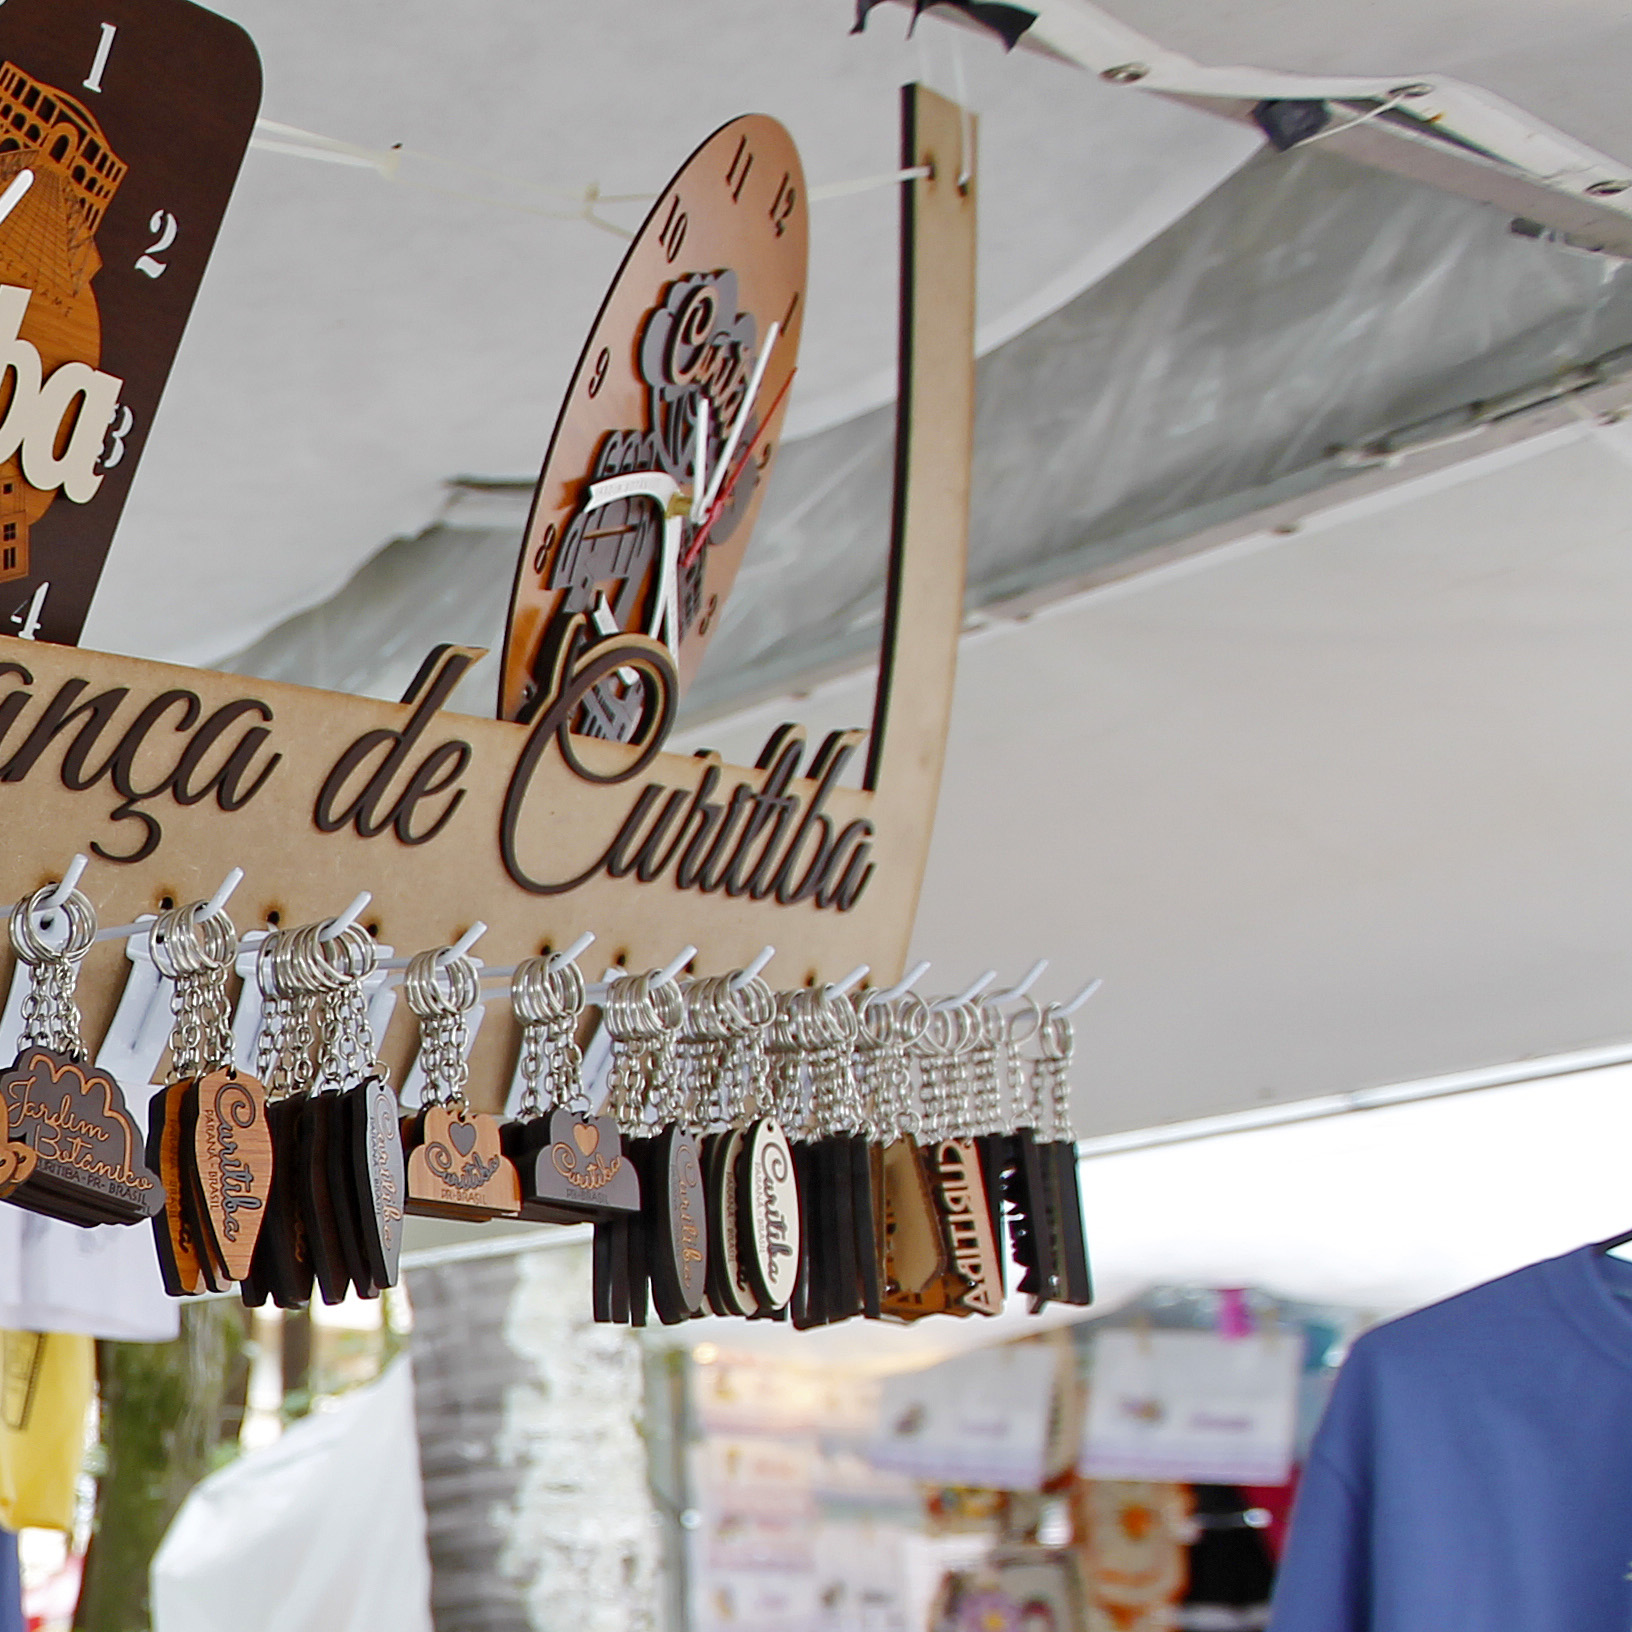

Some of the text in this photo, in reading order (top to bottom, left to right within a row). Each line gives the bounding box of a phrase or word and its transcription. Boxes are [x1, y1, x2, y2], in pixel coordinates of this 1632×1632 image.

[82, 22, 117, 93] 1
[135, 208, 179, 280] 2
[313, 645, 489, 846] de
[498, 613, 878, 913] Curitiba
[7, 1075, 111, 1142] Jardim
[215, 1082, 263, 1244] Curitiba
[424, 1141, 501, 1191] Curitiba
[551, 1141, 622, 1191] Curitiba
[760, 1141, 794, 1286] Curitiba
